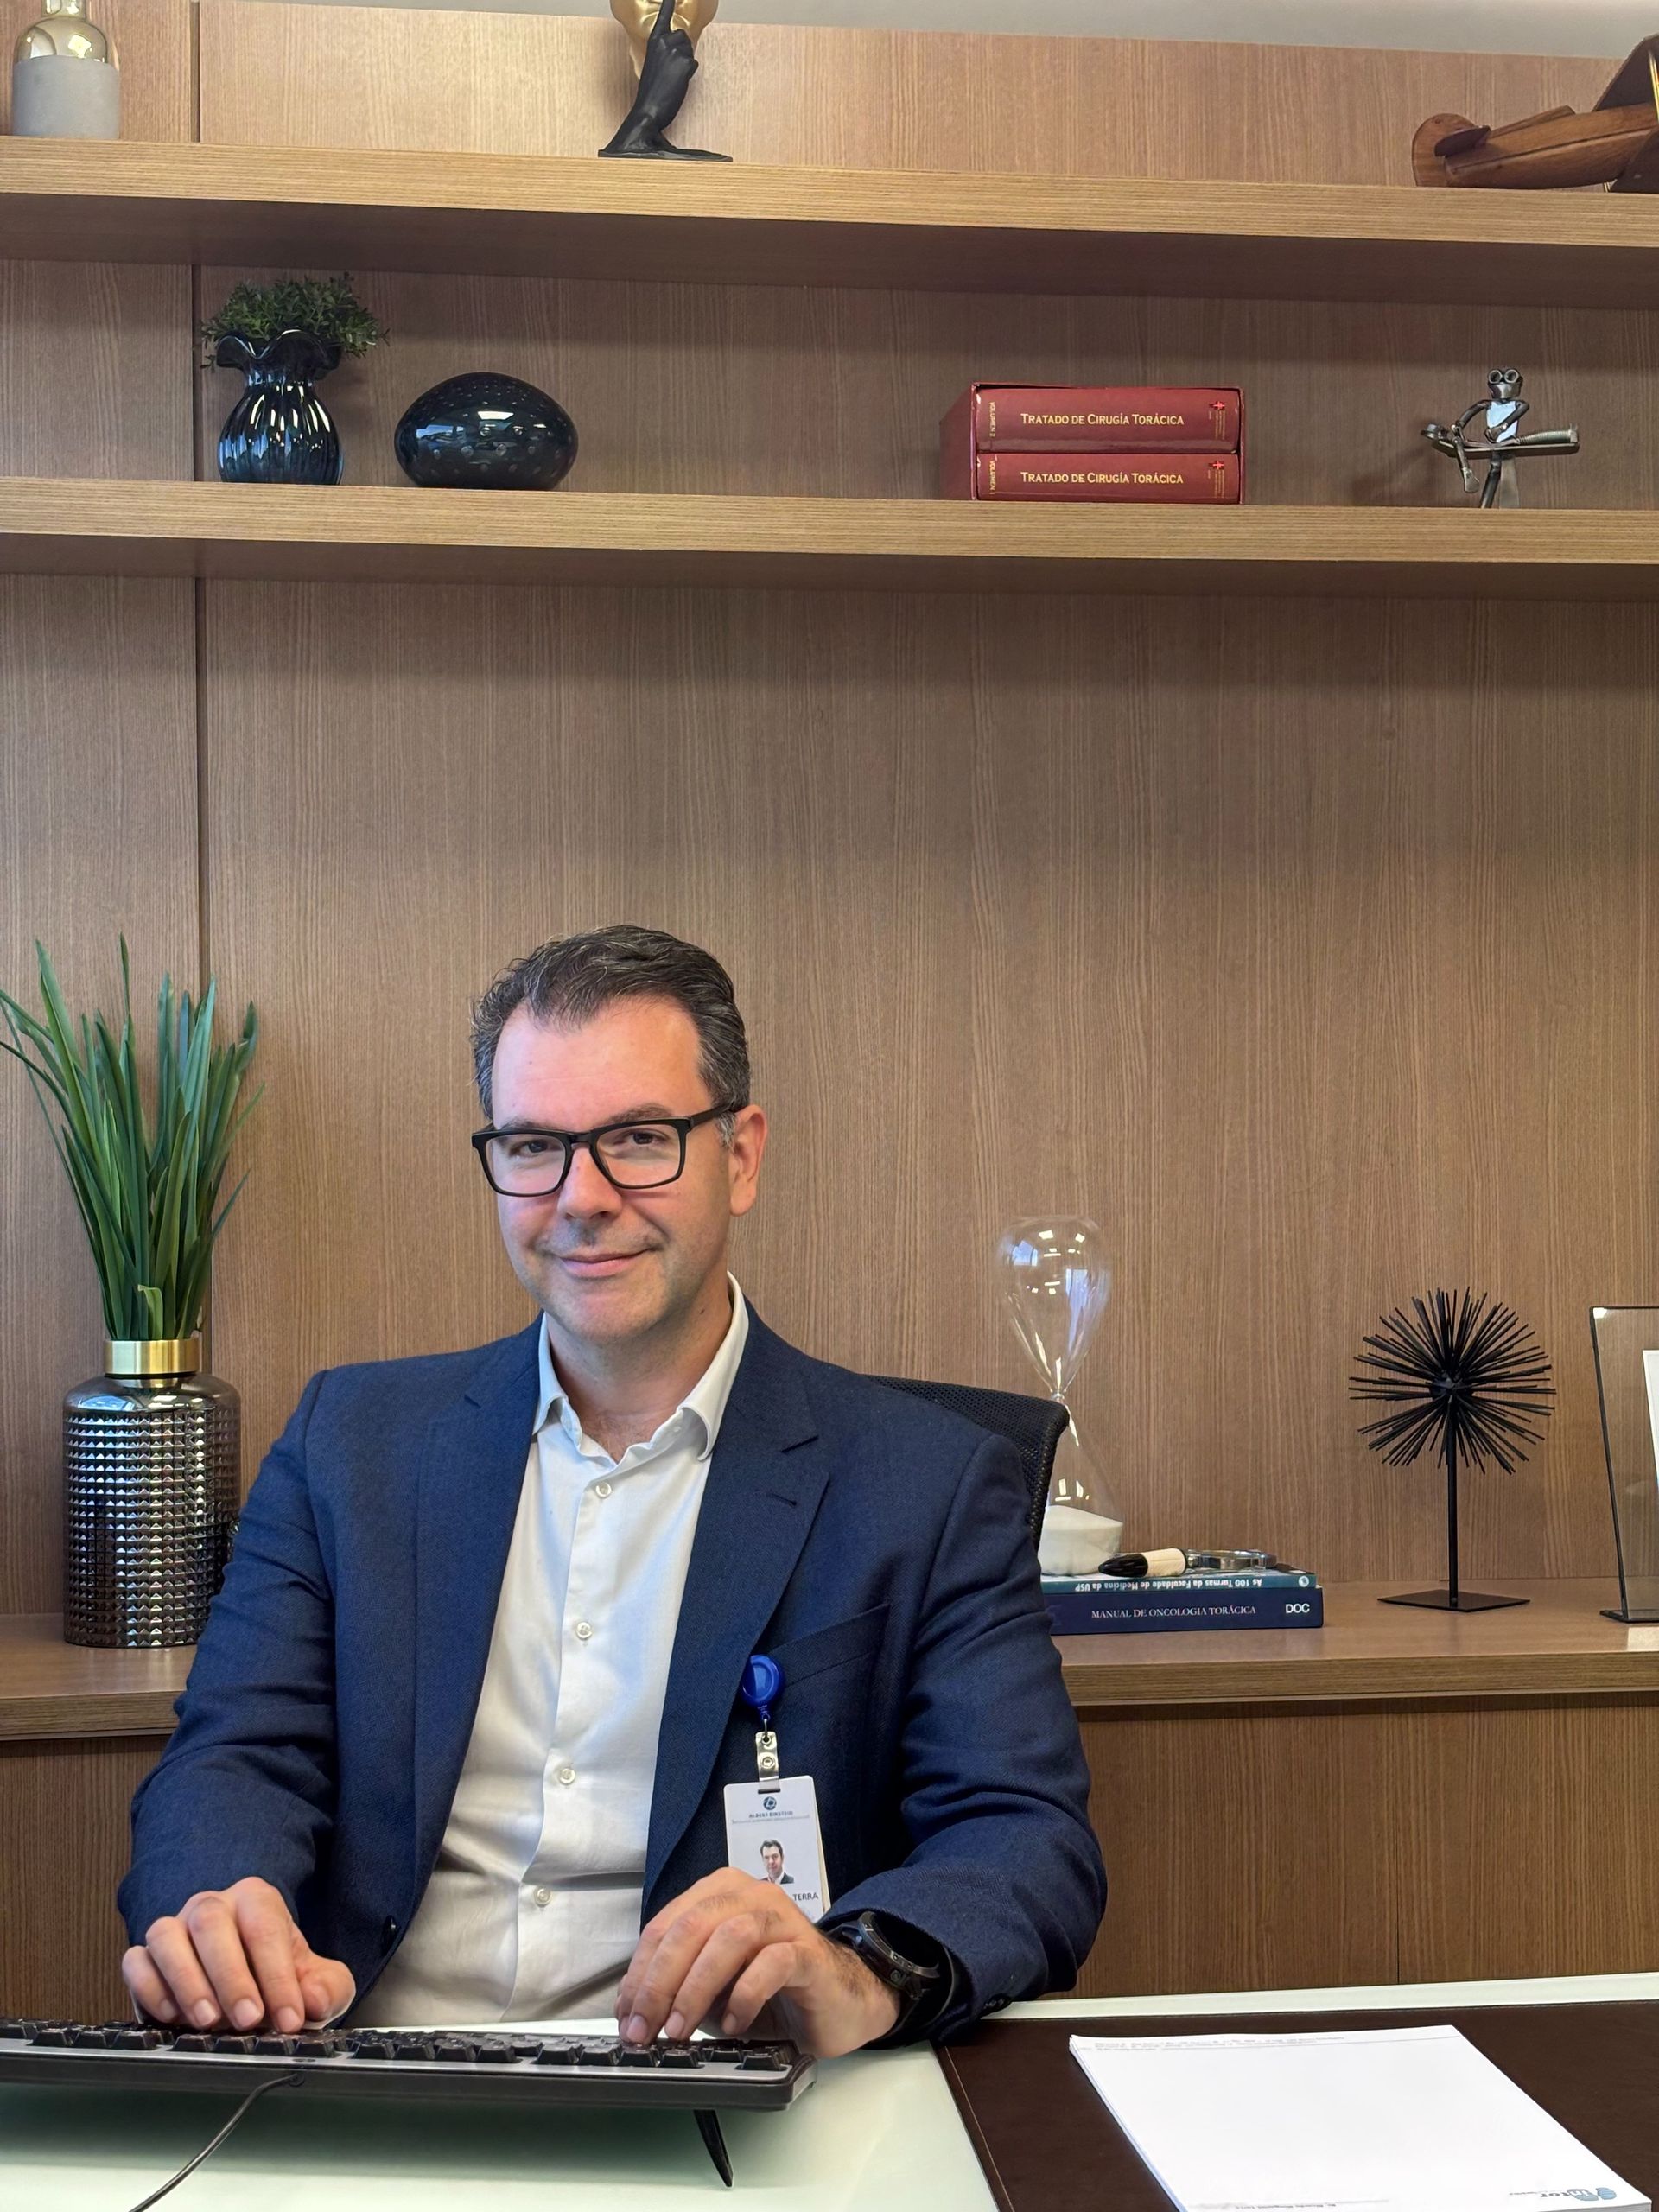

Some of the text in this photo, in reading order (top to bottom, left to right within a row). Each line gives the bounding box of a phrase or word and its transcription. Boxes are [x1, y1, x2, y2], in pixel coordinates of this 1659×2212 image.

[1020, 412, 1185, 425] TRATADO DE CIRUGÍA TORÁCICA
[1020, 471, 1184, 484] TRATADO DE CIRUGÍA TORÁCICA
[1075, 1583, 1090, 1592] USP
[1104, 1581, 1138, 1591] Medicina
[1141, 1581, 1150, 1590] de
[1153, 1580, 1191, 1589] Faculdade
[1192, 1580, 1203, 1589] da
[1205, 1580, 1232, 1588] Turmas
[1235, 1579, 1250, 1587] 100
[1253, 1579, 1262, 1587] As
[1091, 1605, 1256, 1618] MANUAL DE ONCOLOGIA TORÁCICA
[1285, 1603, 1310, 1614] DOC
[792, 1892, 818, 1901] TERRA
